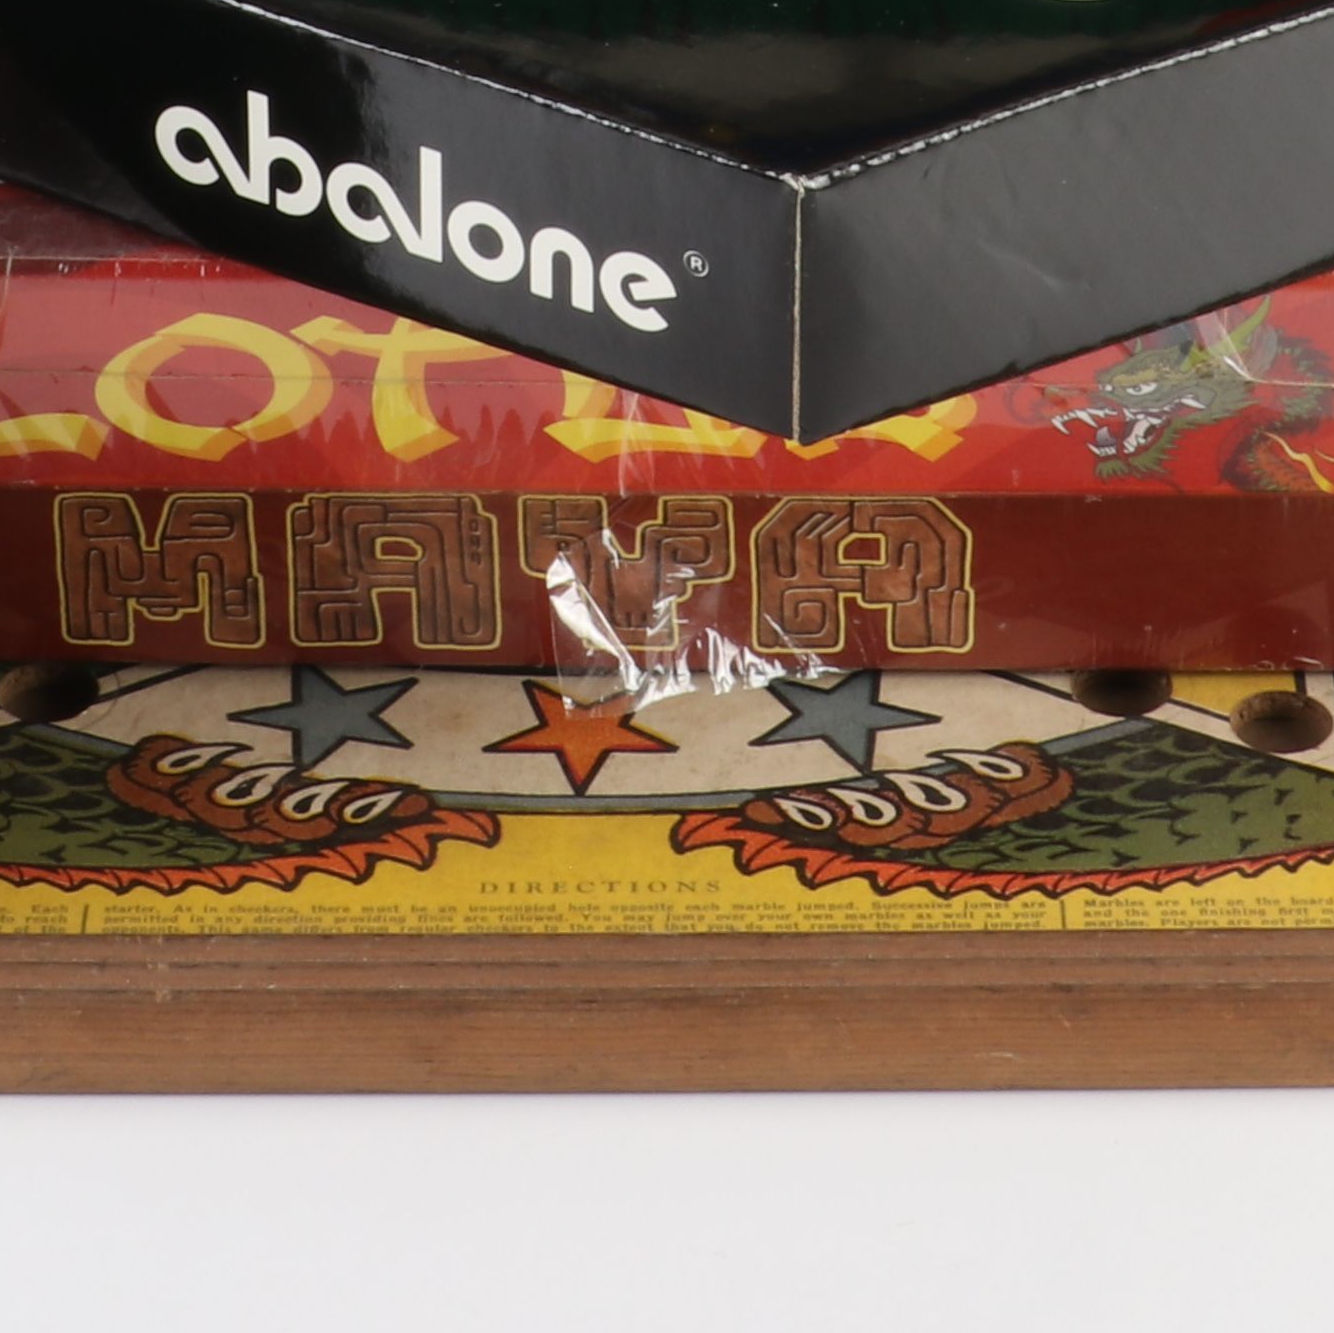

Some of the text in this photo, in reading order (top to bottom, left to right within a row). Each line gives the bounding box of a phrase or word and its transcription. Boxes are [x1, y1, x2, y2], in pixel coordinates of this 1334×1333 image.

[153, 88, 679, 333] abalone
[53, 491, 975, 653] MAYA
[480, 880, 723, 895] DIRECTIONS
